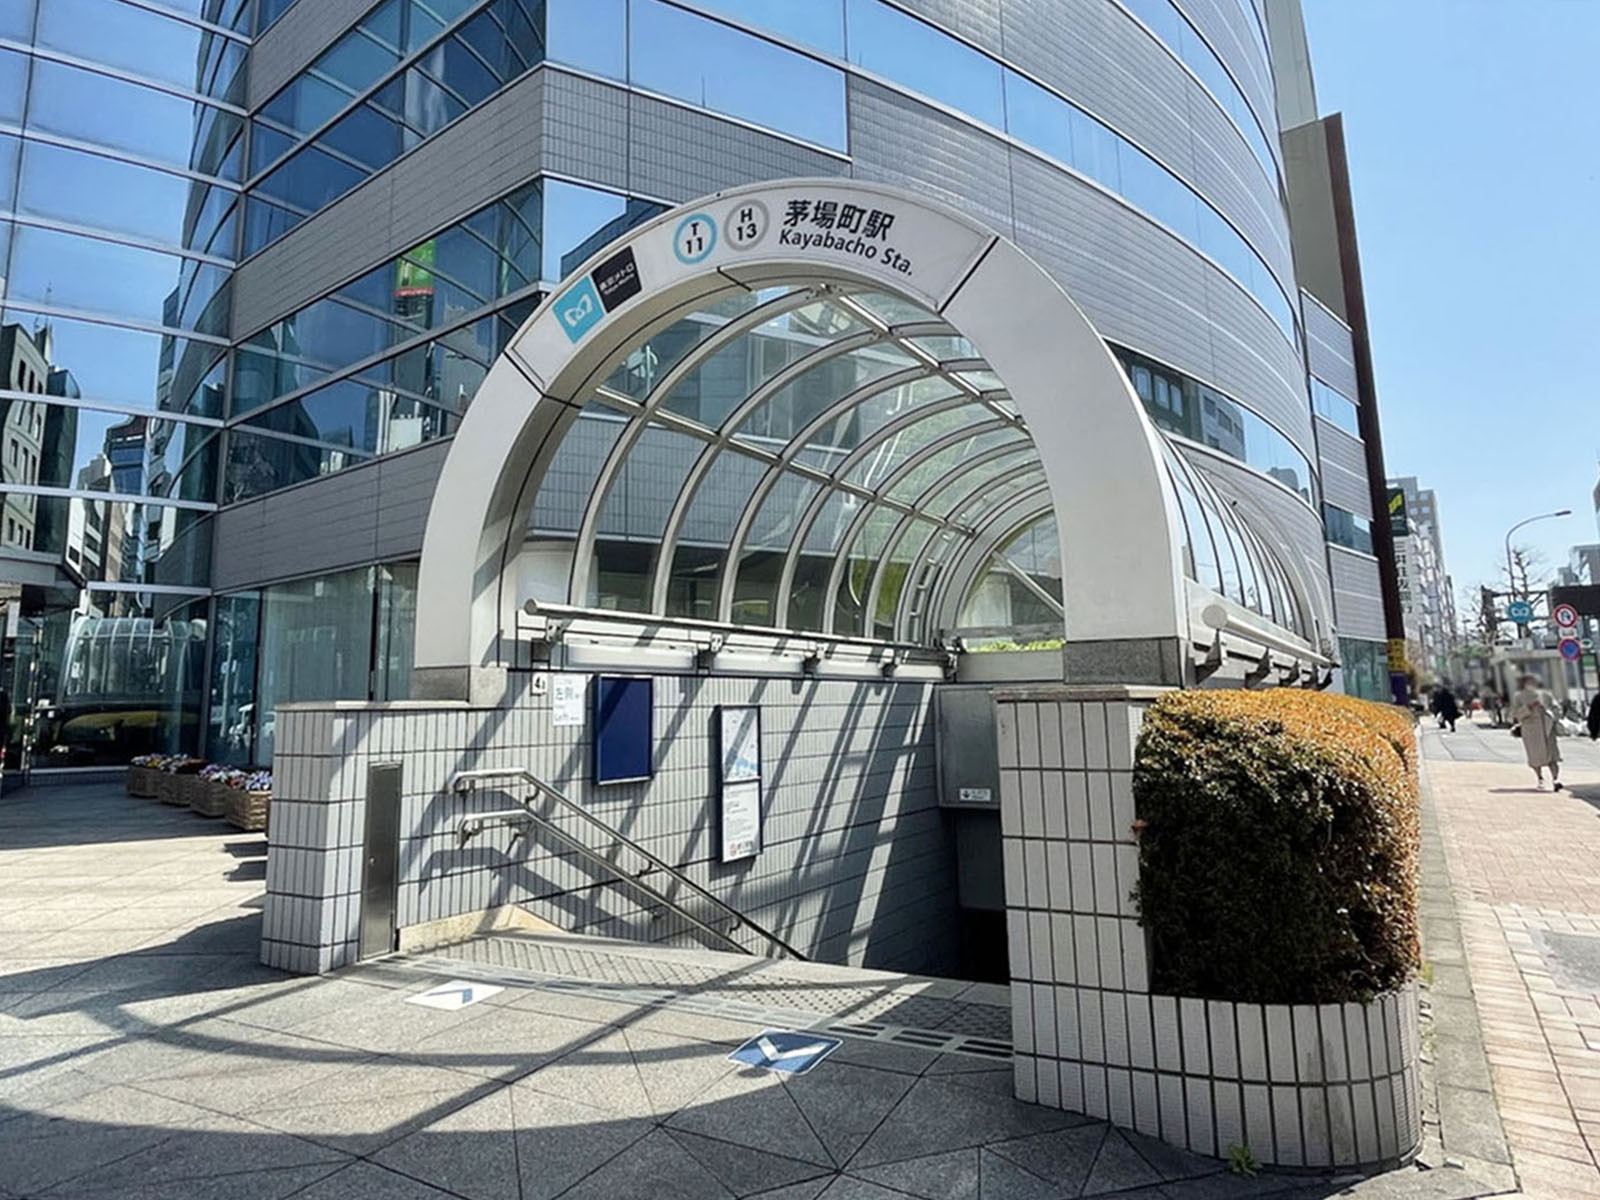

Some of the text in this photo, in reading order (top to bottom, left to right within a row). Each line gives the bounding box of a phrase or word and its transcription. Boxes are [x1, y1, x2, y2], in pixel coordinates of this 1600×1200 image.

[740, 207, 753, 223] H
[783, 200, 895, 241] 茅場町駅
[690, 221, 700, 236] T
[736, 222, 757, 241] 13
[685, 237, 703, 254] 11
[779, 228, 912, 276] Kayabacho Sta.
